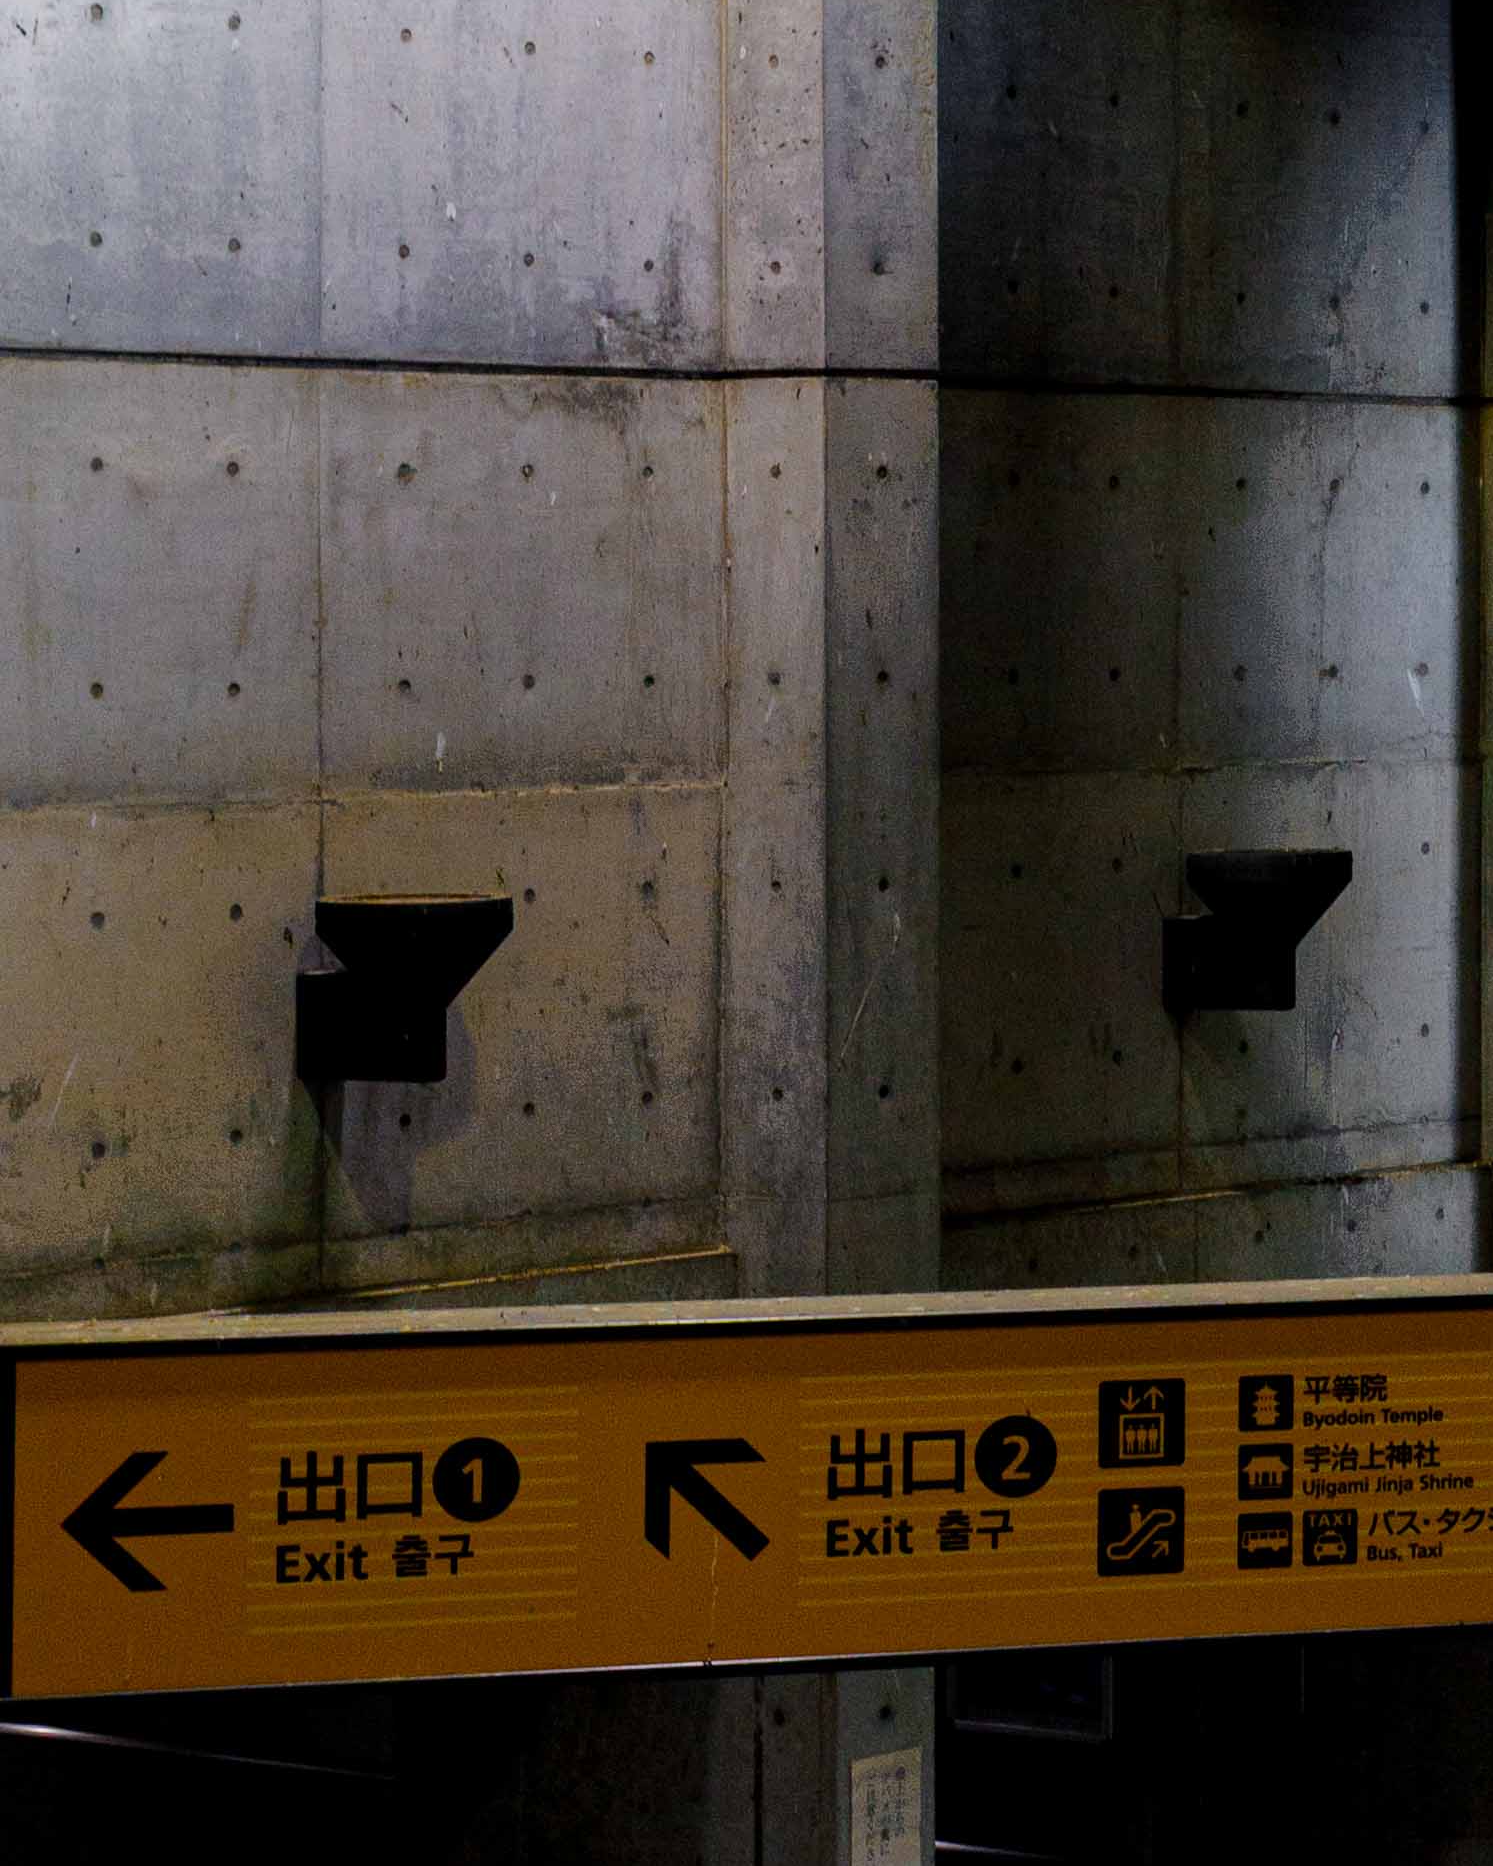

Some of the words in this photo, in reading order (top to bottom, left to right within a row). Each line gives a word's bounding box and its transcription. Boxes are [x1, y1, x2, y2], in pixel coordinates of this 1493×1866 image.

[1303, 1374, 1388, 1403] 平等院
[1303, 1409, 1375, 1429] Byodoin
[1382, 1406, 1444, 1427] Temple
[827, 1429, 966, 1499] 出口
[1303, 1439, 1440, 1472] 宇治上神社
[277, 1451, 424, 1525] 出口
[1302, 1477, 1369, 1498] Ujigami
[1375, 1477, 1413, 1496] Jinja
[1420, 1474, 1474, 1492] Shrine
[826, 1516, 914, 1557] Exit
[936, 1510, 1014, 1551] 출구
[1308, 1514, 1352, 1526] TAXI
[276, 1541, 369, 1583] Exit
[391, 1534, 475, 1578] 출구
[1367, 1544, 1402, 1562] Bus,
[1410, 1543, 1443, 1560] Taxi
